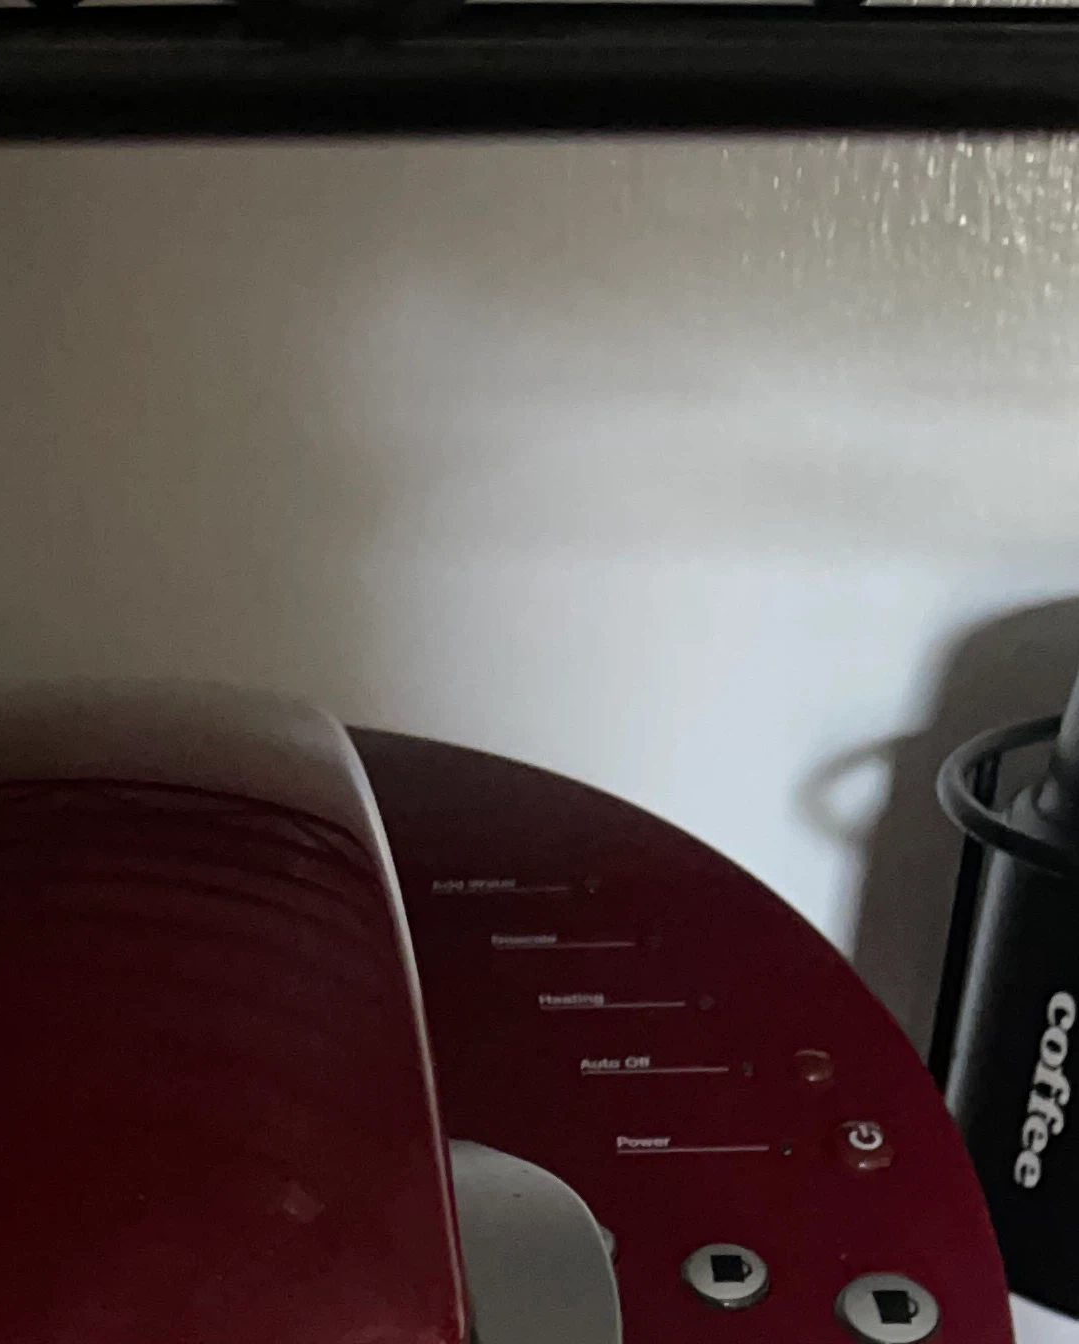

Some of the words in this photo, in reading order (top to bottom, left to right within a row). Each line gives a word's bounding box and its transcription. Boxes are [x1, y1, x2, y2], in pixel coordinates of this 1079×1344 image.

[538, 992, 605, 1006] Heating
[580, 1057, 620, 1070] Auto
[625, 1055, 651, 1068] Off
[1013, 990, 1077, 1190] coffee
[616, 1135, 671, 1148] Power
